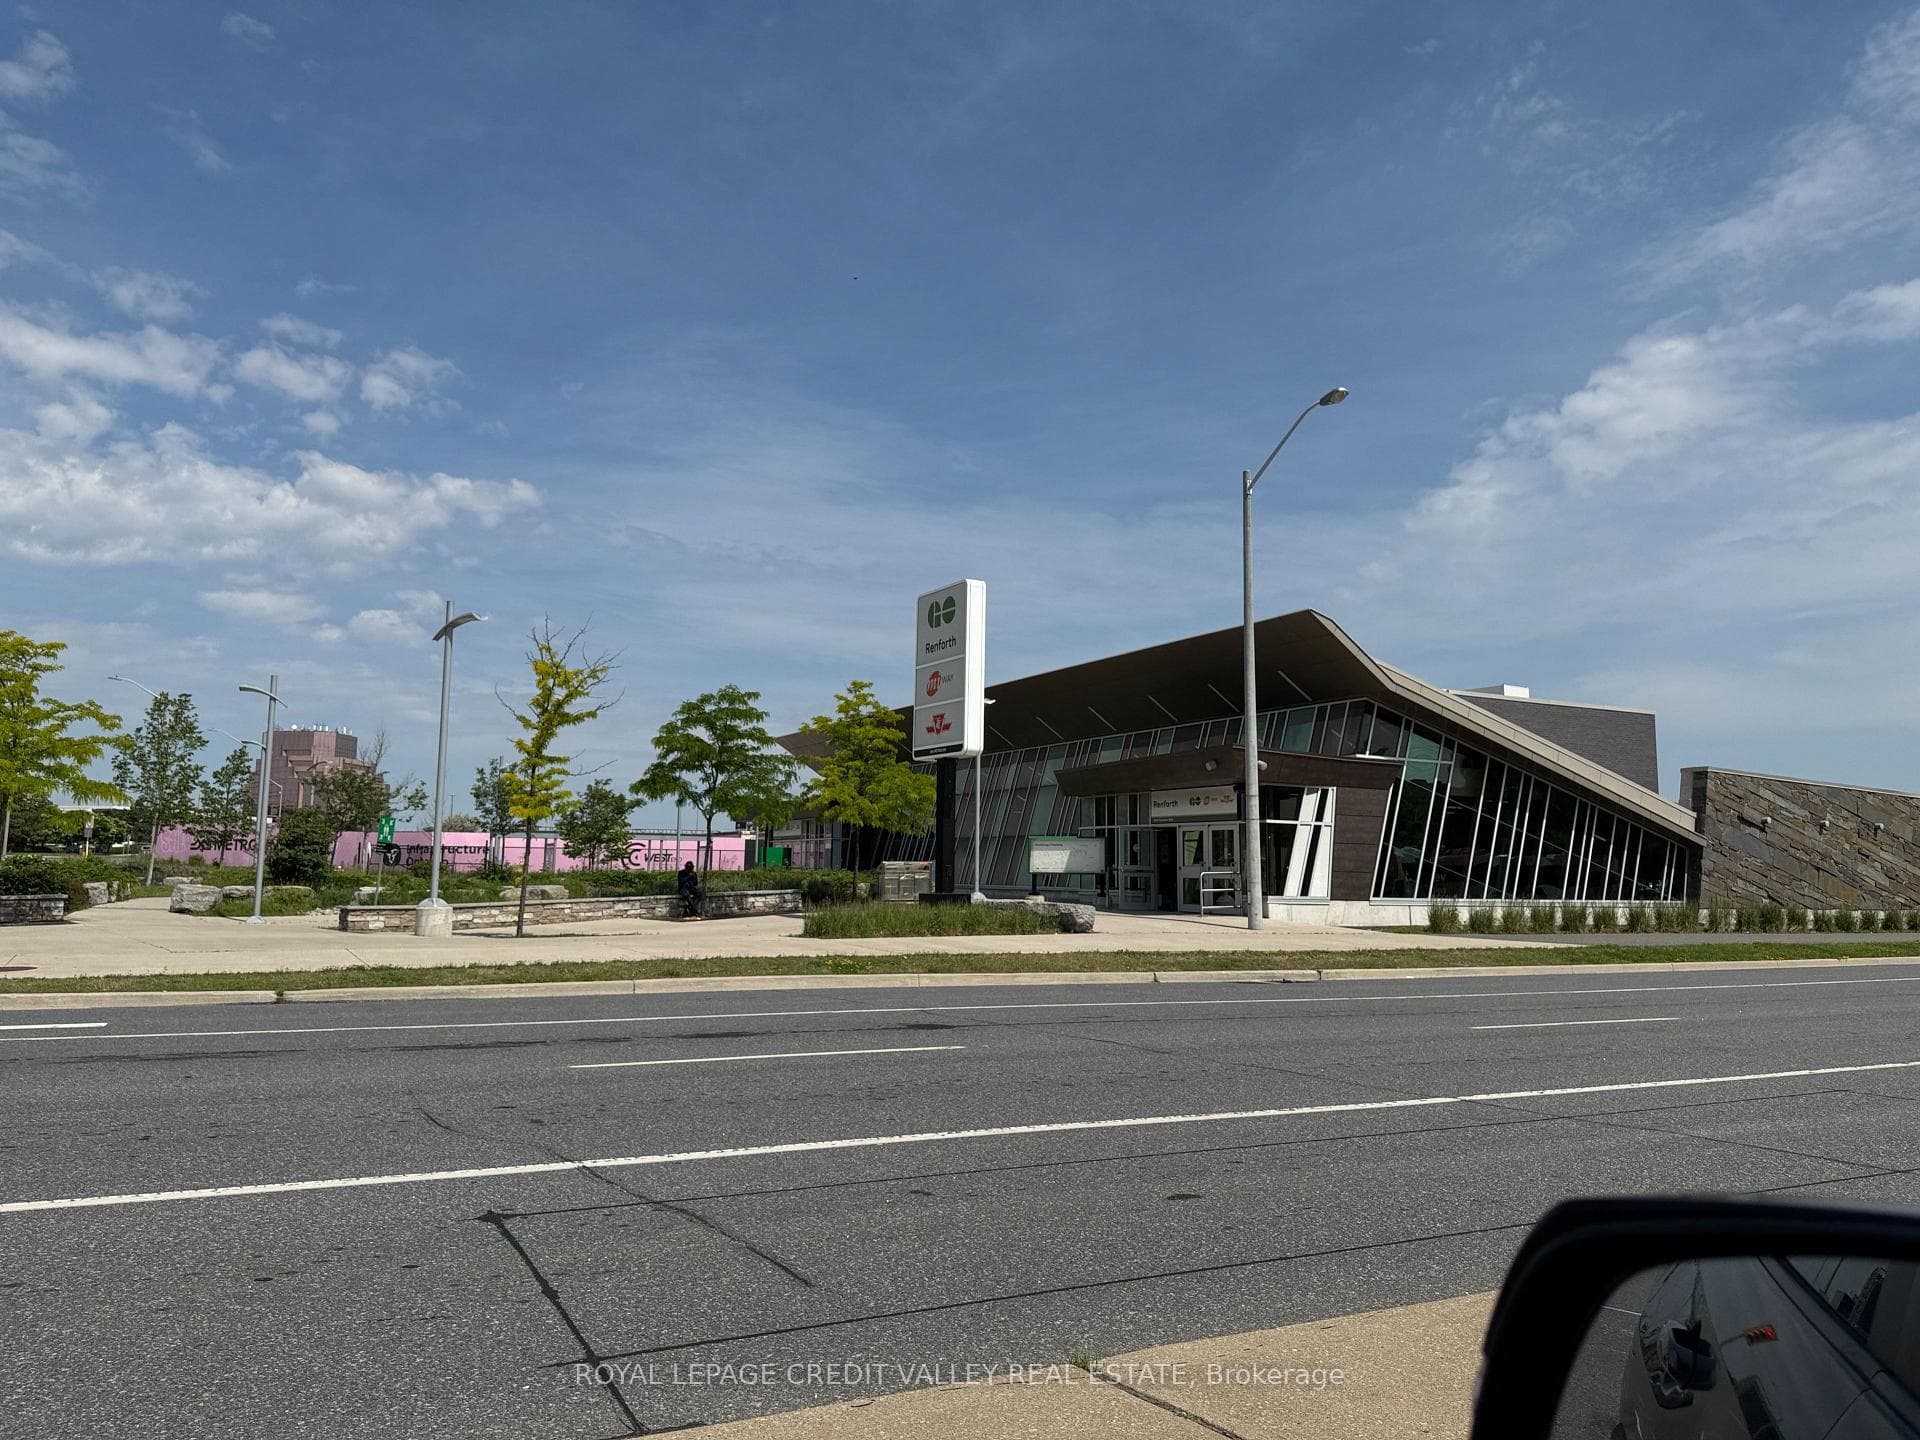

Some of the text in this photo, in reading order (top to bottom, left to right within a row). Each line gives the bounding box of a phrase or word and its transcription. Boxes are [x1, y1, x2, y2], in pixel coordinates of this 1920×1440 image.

[925, 635, 957, 654] Renforth
[1153, 799, 1178, 809] Renforth
[406, 843, 490, 855] Infraructure
